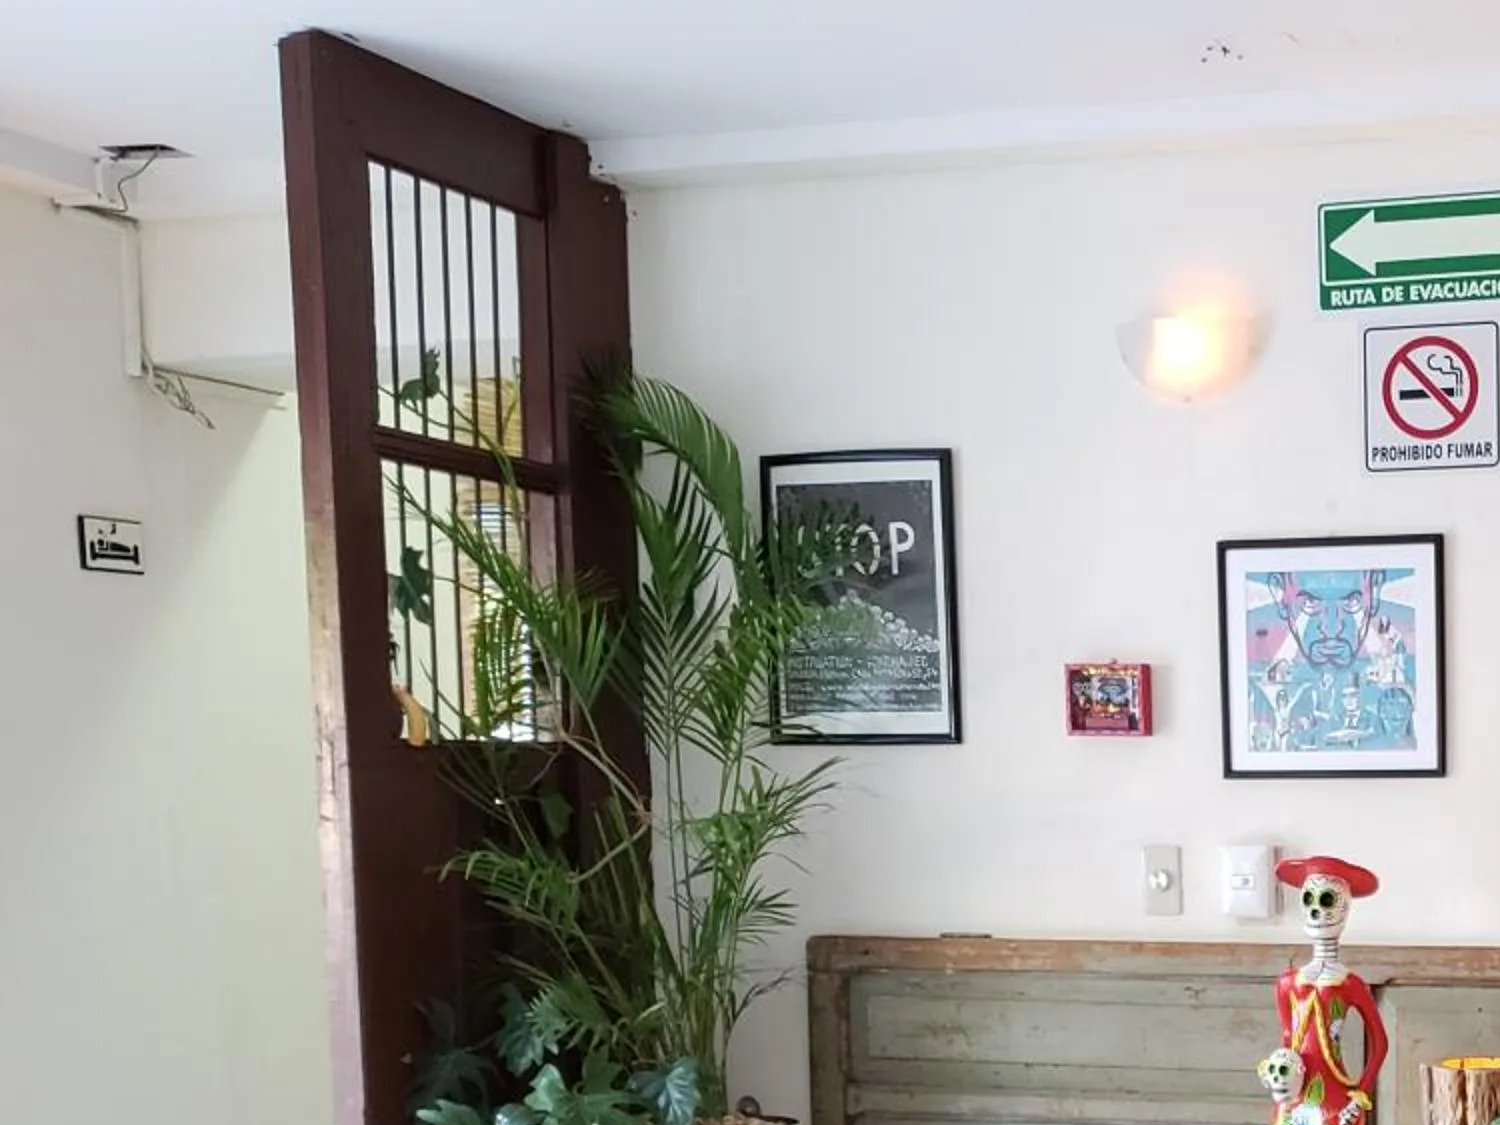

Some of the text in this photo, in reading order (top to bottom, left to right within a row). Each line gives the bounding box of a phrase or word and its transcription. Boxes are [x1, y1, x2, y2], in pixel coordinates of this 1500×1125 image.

[1330, 289, 1376, 307] RUTA
[1382, 285, 1405, 302] DE
[1371, 442, 1493, 462] PROHIBIDO FUMAR
